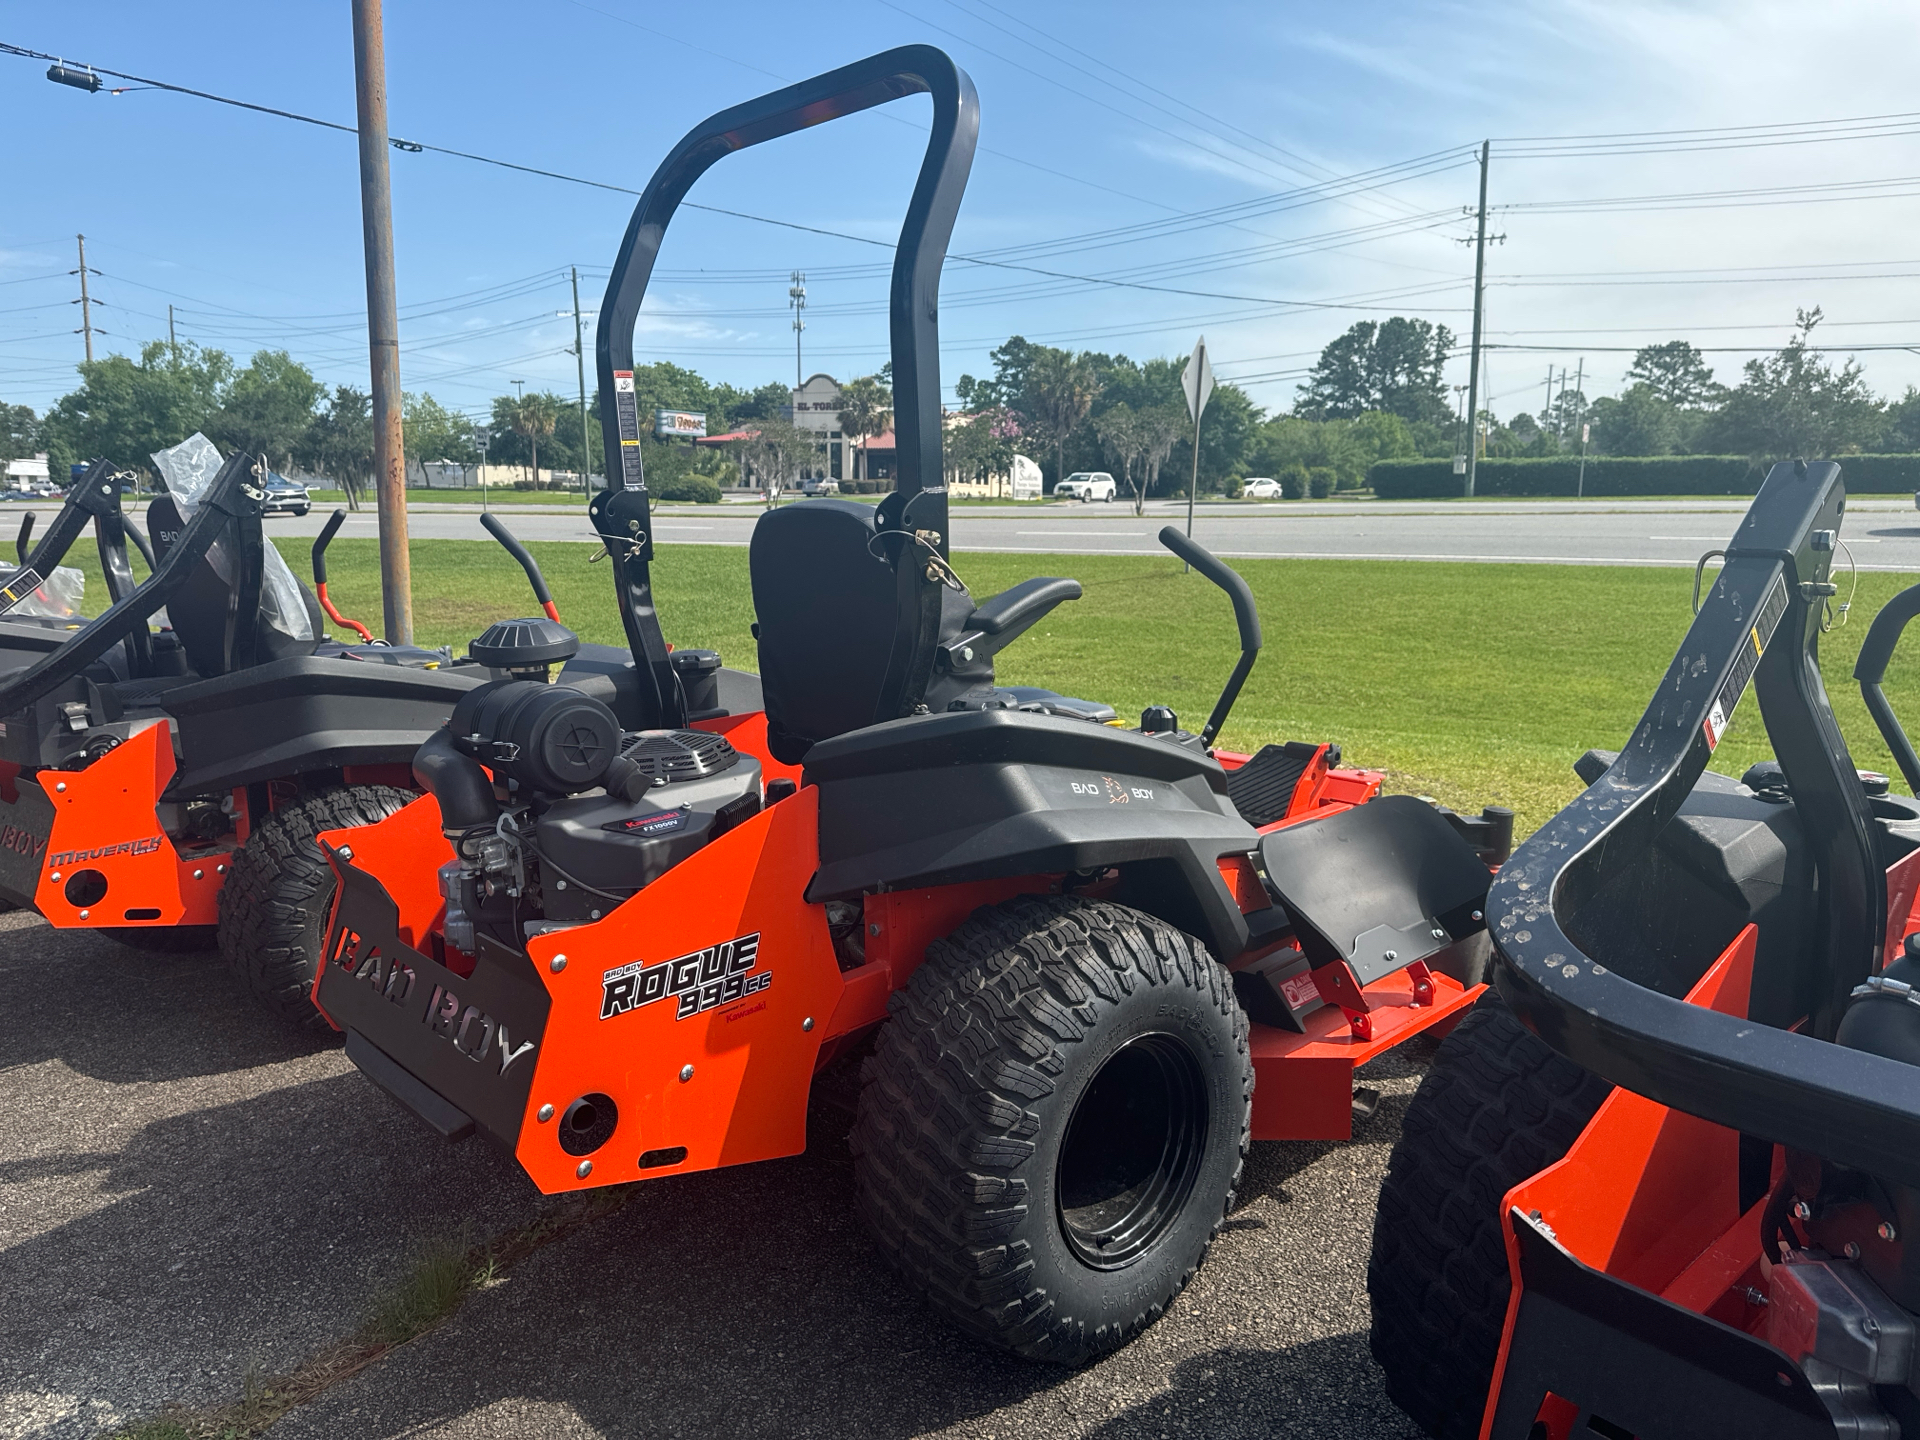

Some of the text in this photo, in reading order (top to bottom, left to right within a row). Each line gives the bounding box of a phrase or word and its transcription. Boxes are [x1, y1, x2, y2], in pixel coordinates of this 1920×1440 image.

[1071, 782, 1154, 800] BAD BOY
[625, 811, 680, 828] Kawasaki
[0, 824, 47, 859] BOY
[49, 835, 164, 868] MAVERICK
[600, 931, 761, 1020] ROGUE
[604, 961, 643, 980] BAD BOY
[331, 926, 535, 1077] BAD BOY
[725, 1000, 767, 1023] Kawasaki
